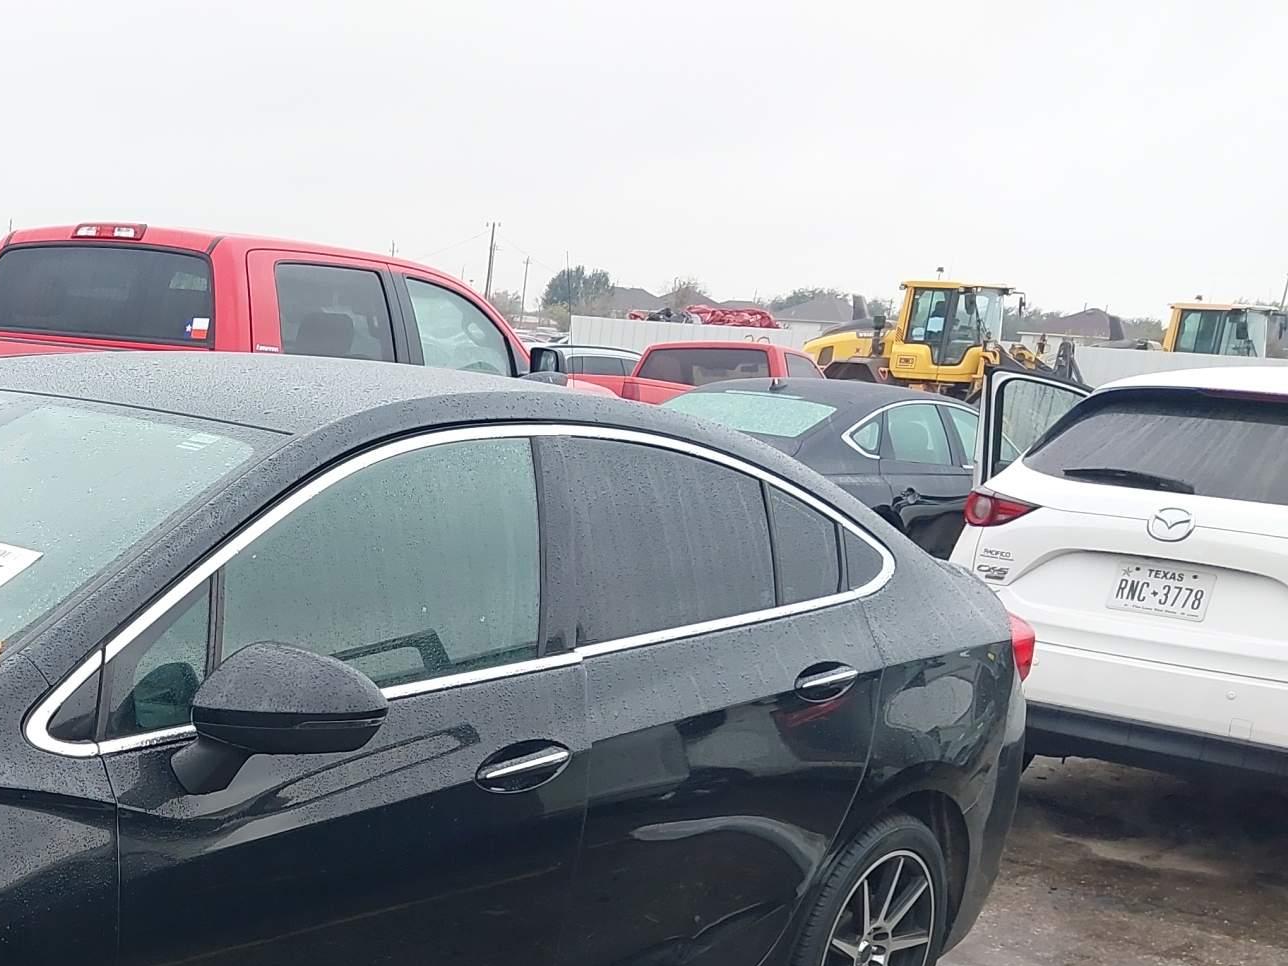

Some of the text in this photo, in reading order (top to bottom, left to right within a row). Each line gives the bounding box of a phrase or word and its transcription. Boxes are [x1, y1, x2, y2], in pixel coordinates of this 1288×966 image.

[1147, 568, 1185, 582] TEXAS
[1115, 578, 1150, 602] RNC
[1158, 584, 1205, 610] 3778
